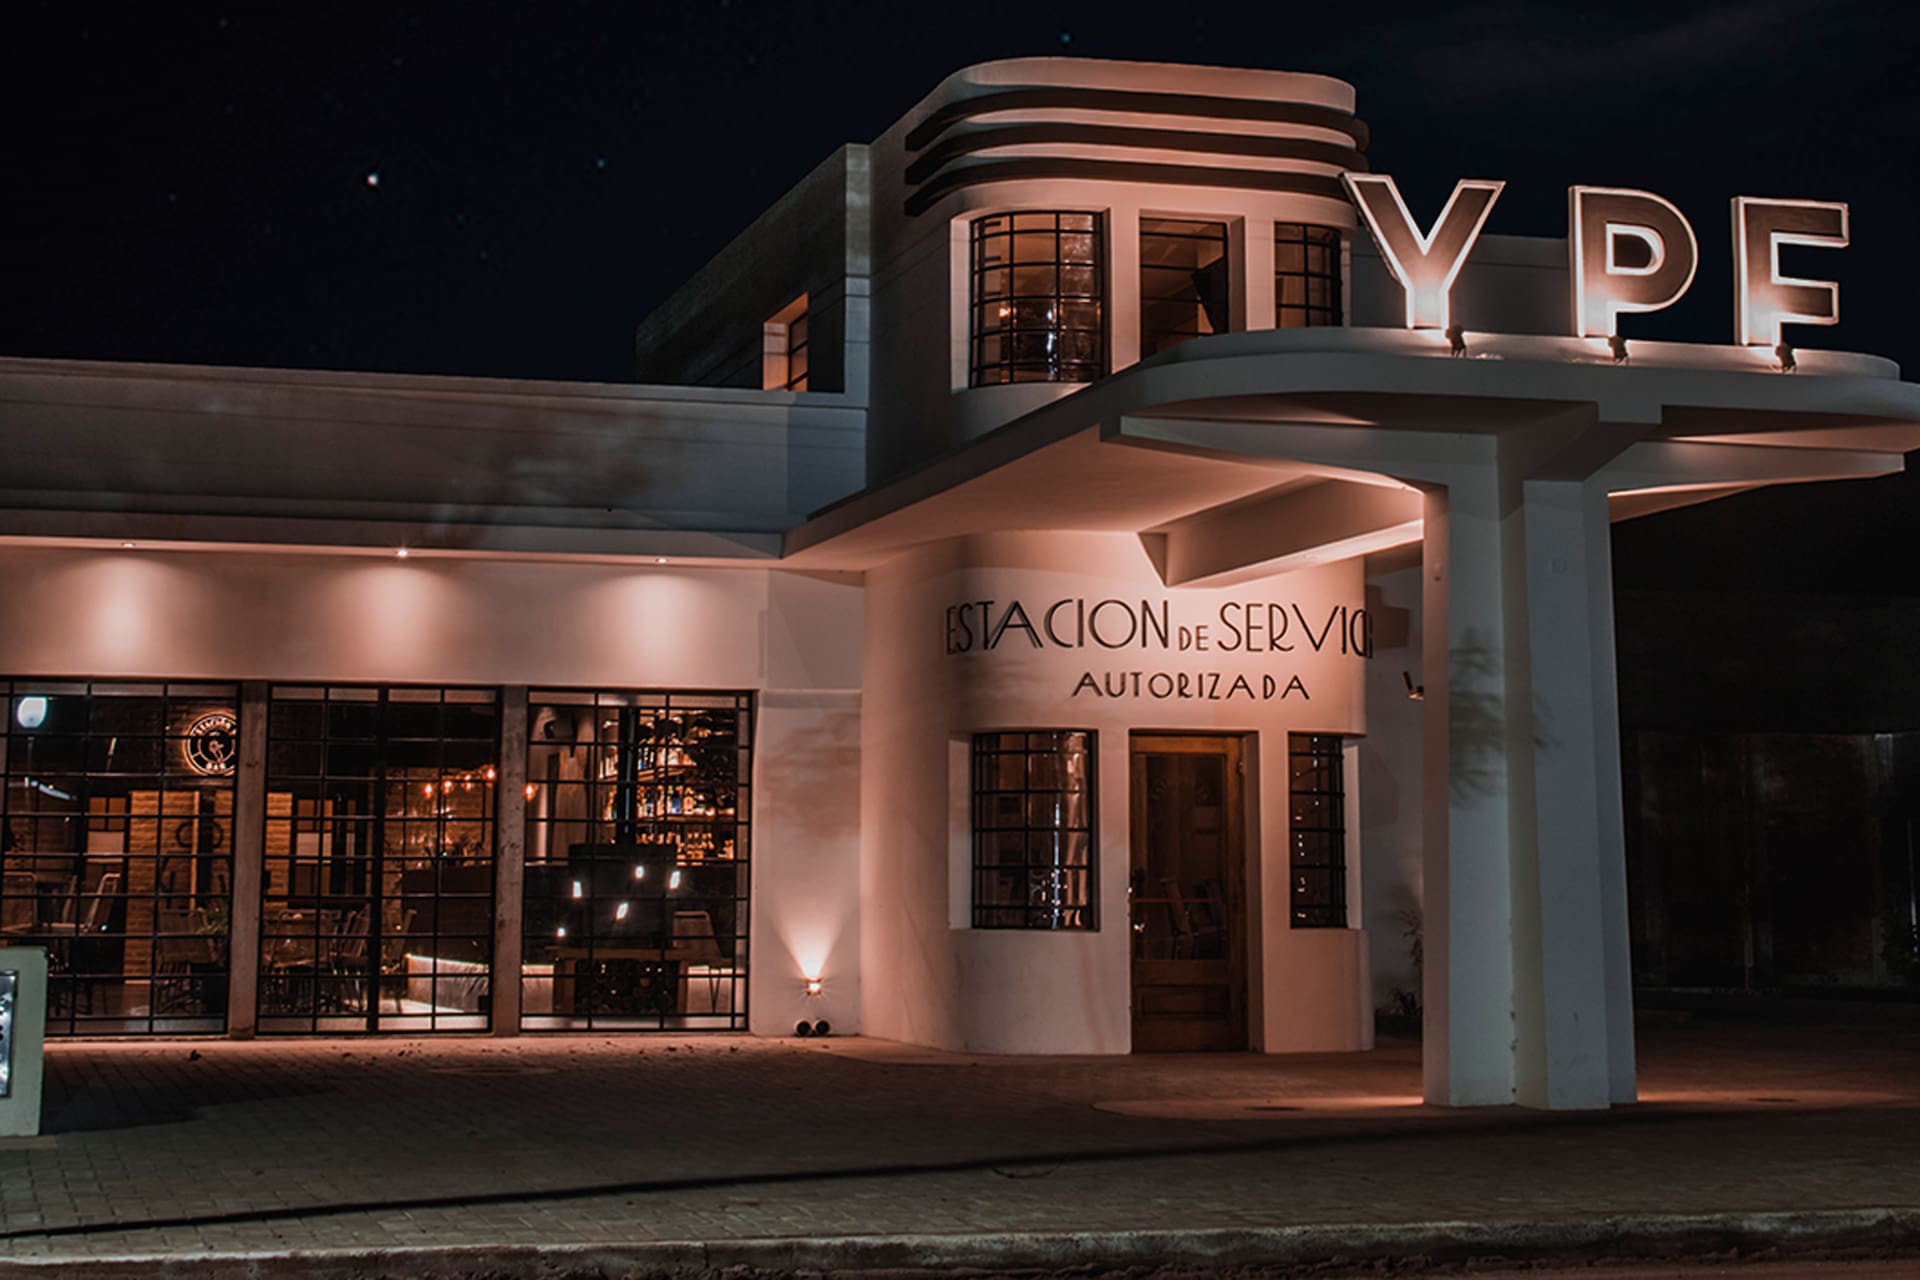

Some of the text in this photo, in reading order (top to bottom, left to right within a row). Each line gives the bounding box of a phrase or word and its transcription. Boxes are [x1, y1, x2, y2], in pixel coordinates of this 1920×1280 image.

[1341, 172, 1850, 347] YPF
[946, 599, 1169, 656] ESTACION
[1179, 626, 1209, 651] DE
[1072, 671, 1311, 700] AUTORIZADA
